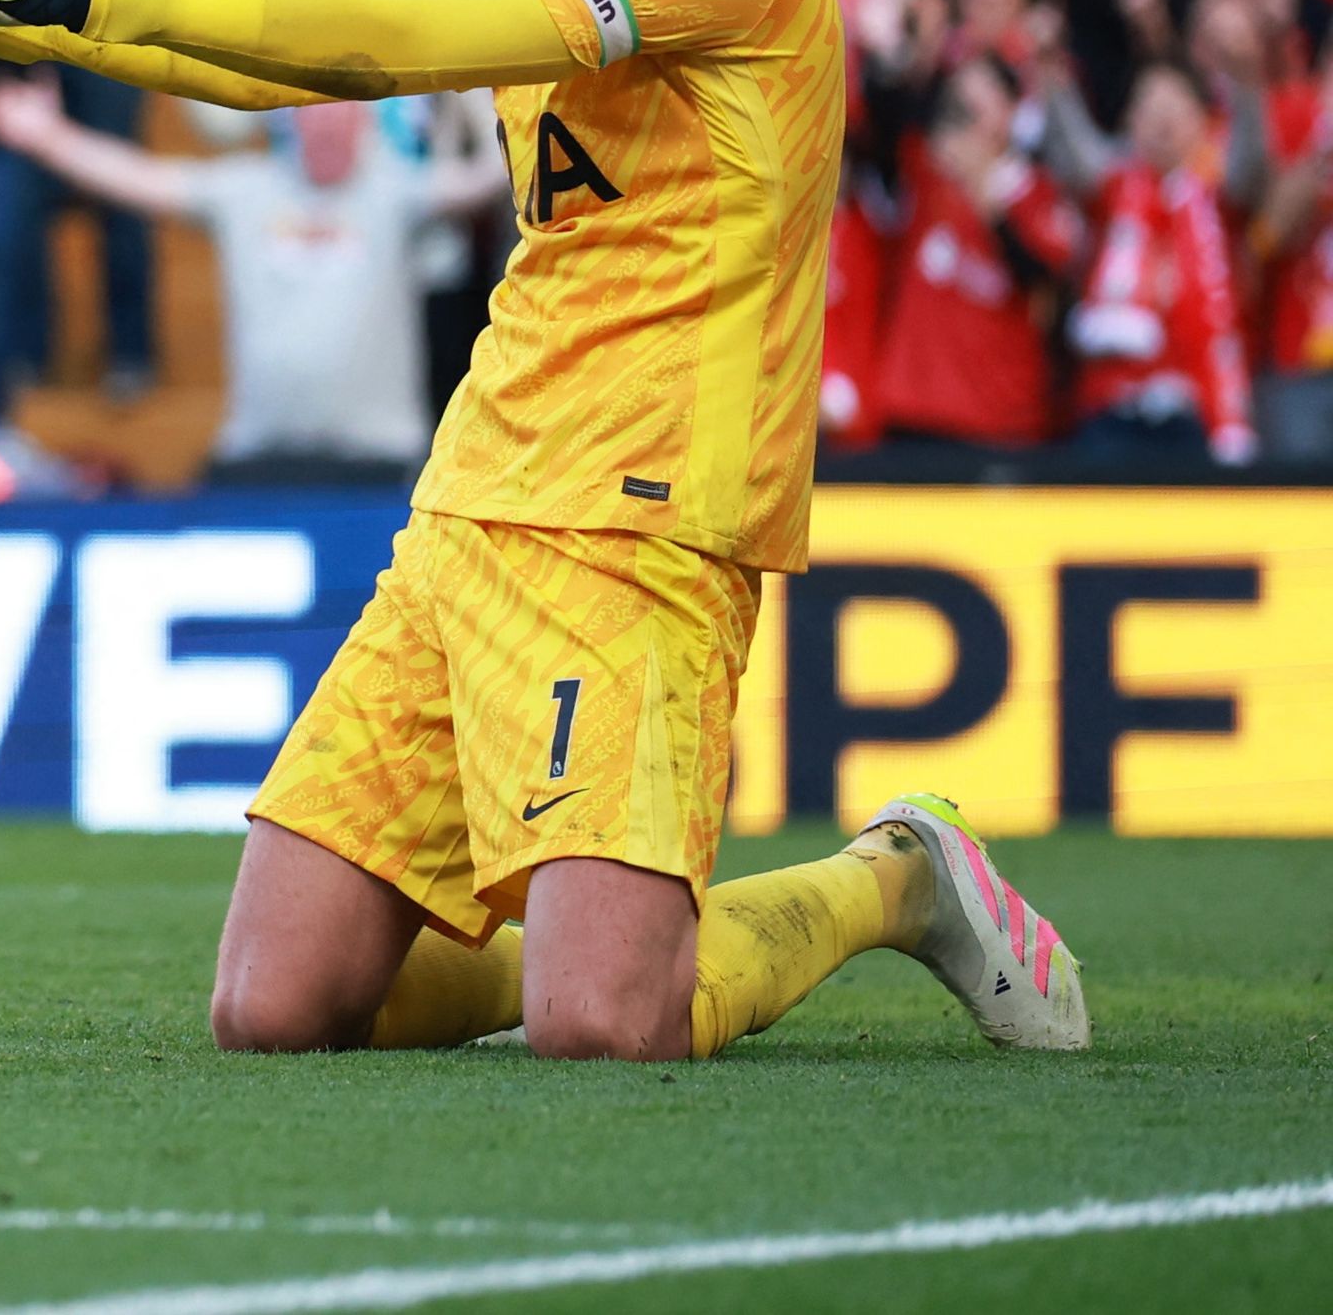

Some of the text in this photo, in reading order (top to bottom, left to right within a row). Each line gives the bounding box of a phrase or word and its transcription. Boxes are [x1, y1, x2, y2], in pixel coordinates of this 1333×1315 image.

[497, 111, 625, 223] A
[549, 678, 582, 780] 1
[727, 561, 1263, 821] PF
